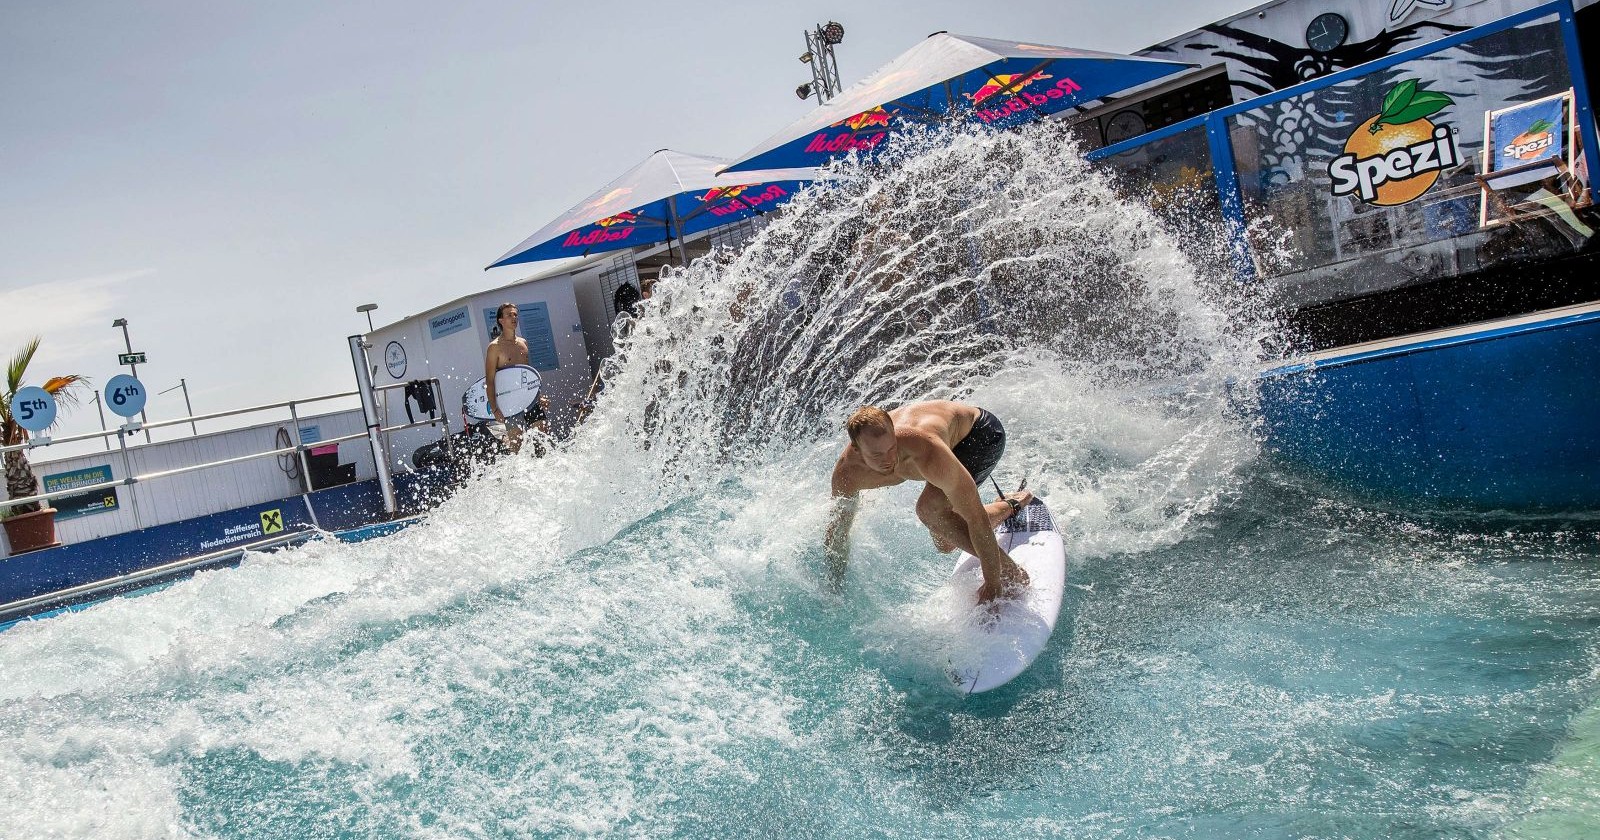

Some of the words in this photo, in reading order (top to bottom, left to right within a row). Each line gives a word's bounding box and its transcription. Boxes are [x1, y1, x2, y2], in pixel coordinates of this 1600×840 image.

[1503, 133, 1553, 159] Spezi
[1329, 125, 1456, 200] Spezi
[113, 385, 138, 406] 6th
[20, 398, 47, 420] 5th
[47, 479, 59, 487] DIE
[60, 475, 83, 483] WELLE
[92, 471, 104, 479] DIE
[48, 483, 70, 492] STADT
[200, 529, 261, 550] Niederösterreich
[224, 523, 260, 535] Raiffeisen
